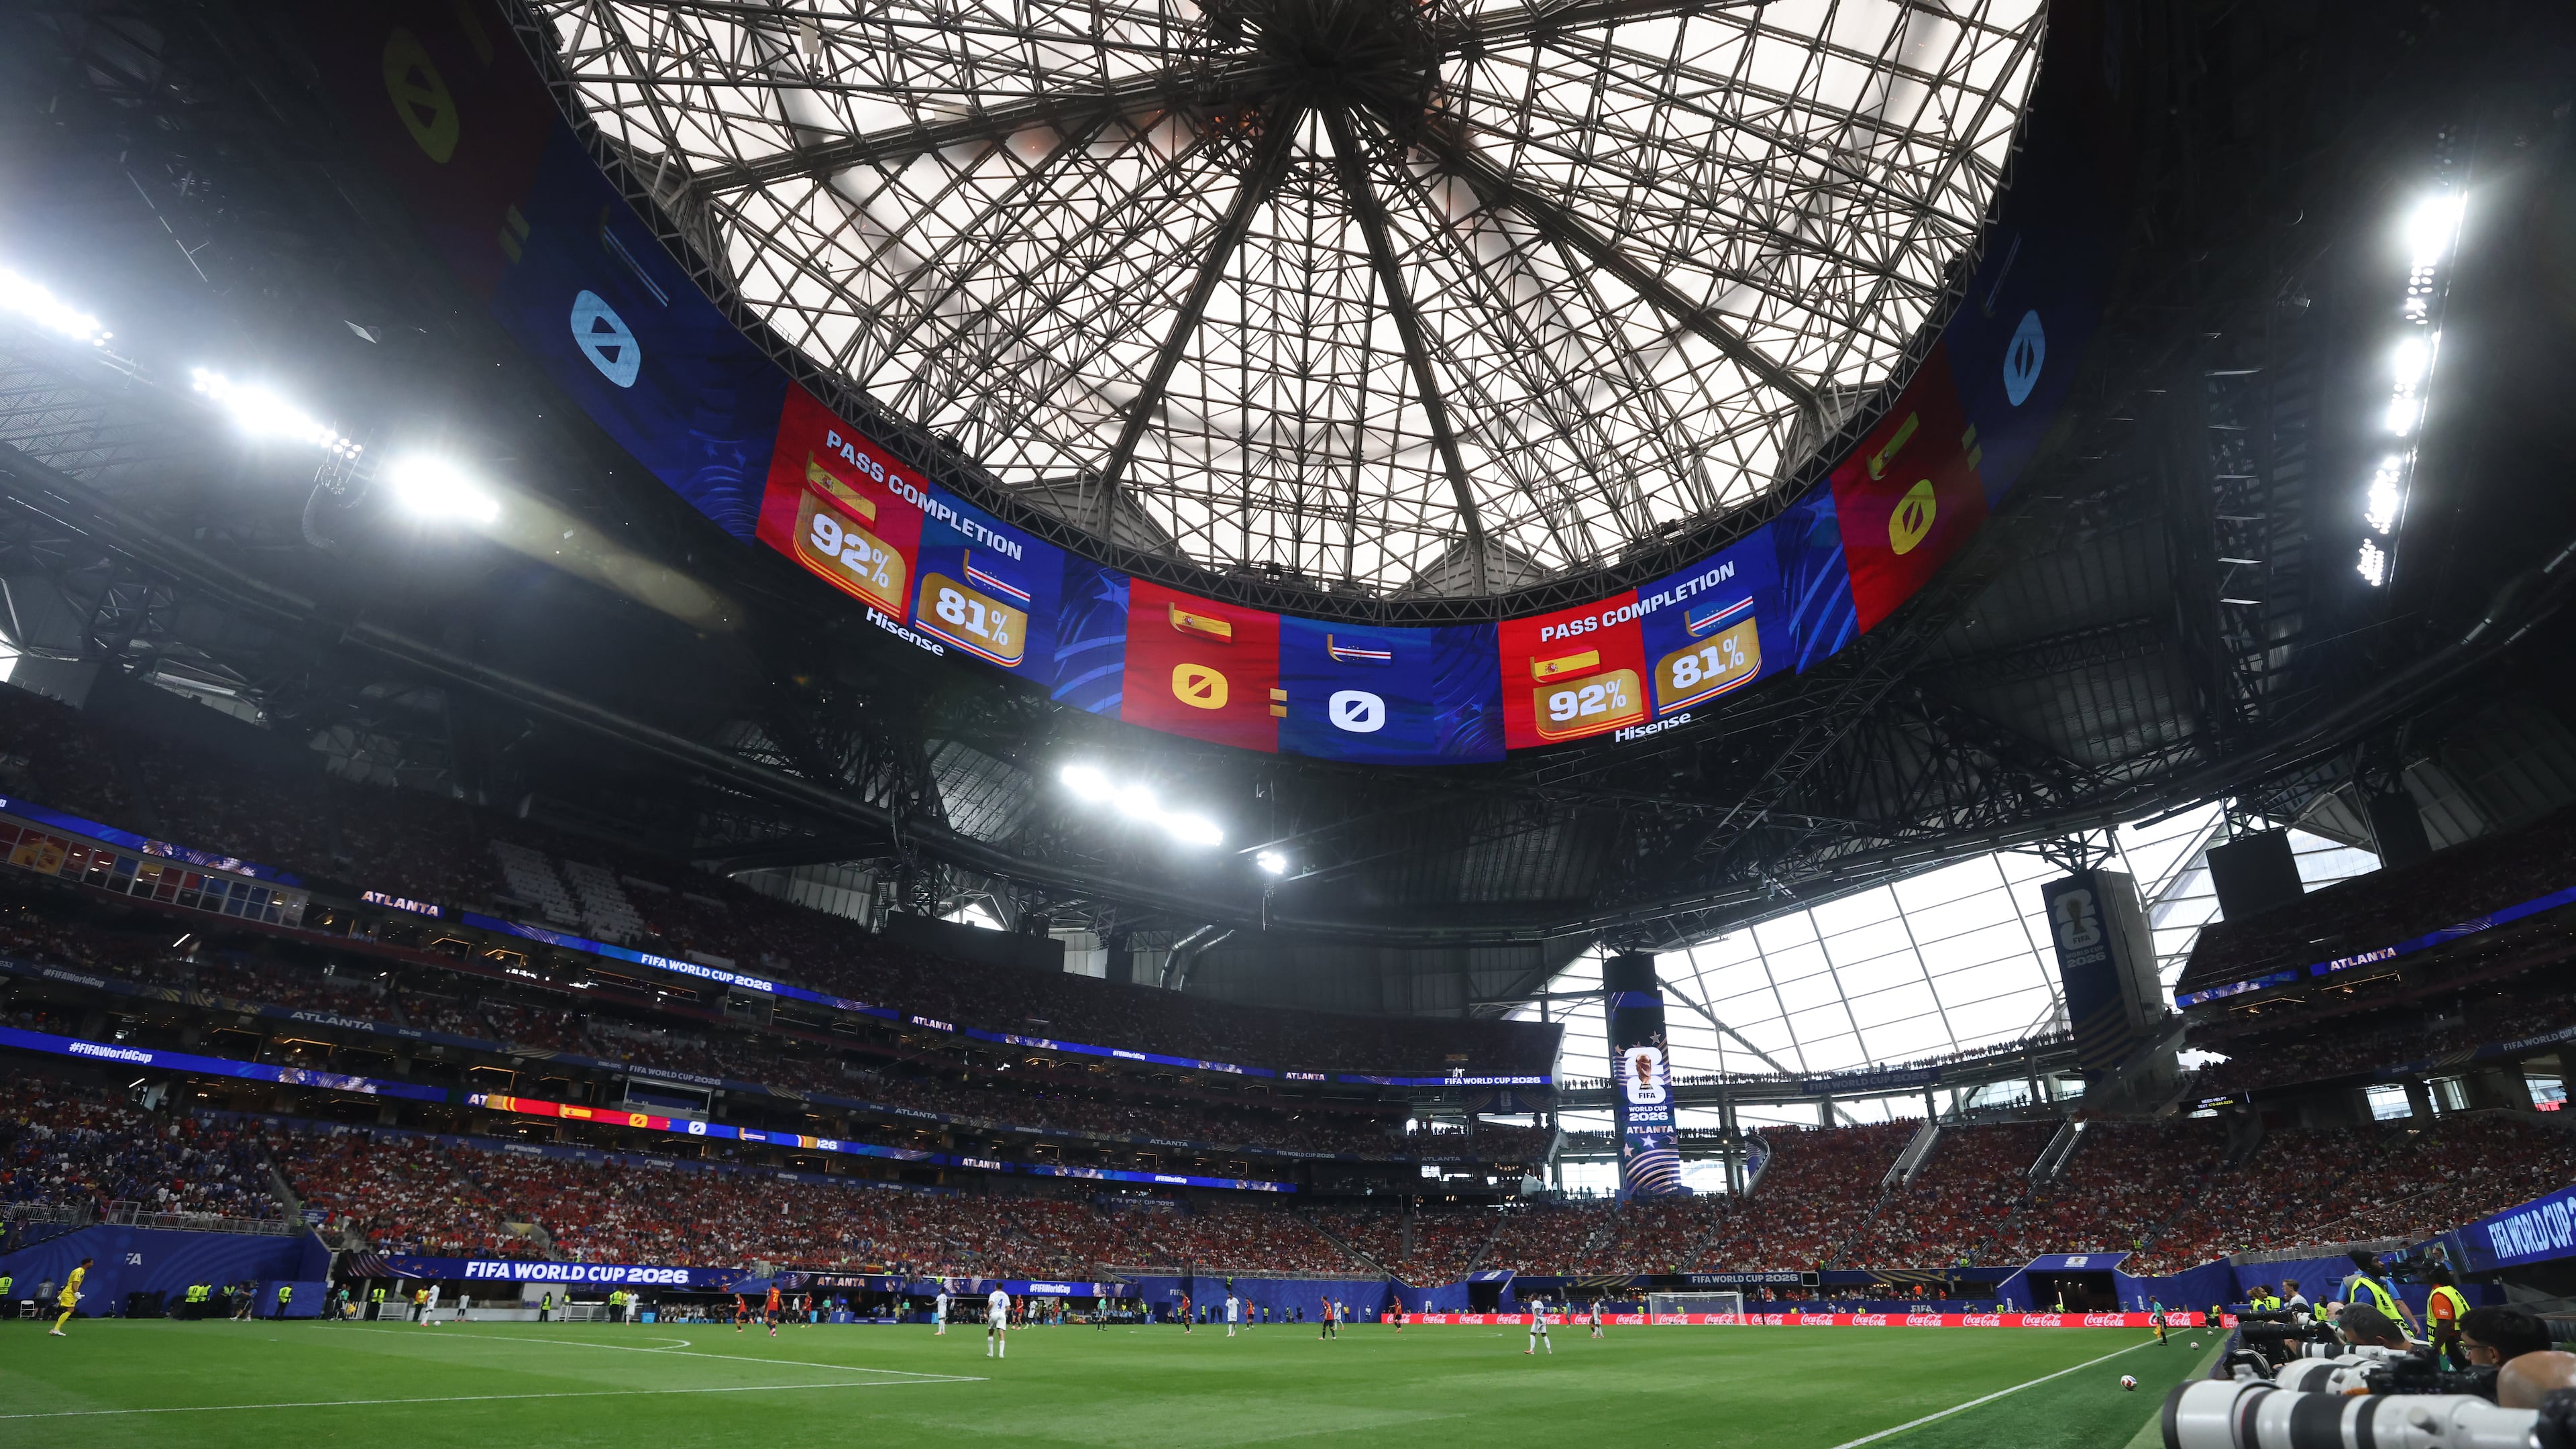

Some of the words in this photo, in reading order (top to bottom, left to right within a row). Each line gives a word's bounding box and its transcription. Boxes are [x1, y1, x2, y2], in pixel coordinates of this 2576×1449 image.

[826, 429, 885, 483] PASS
[888, 473, 1023, 561] COMPLETION
[810, 513, 890, 589] 92%
[1541, 614, 1599, 642] PASS
[1602, 561, 1735, 627] COMPLETION
[936, 586, 1008, 646] 81%
[866, 606, 945, 657] Hisense
[1672, 635, 1744, 689] 81%
[1172, 663, 1228, 709] 0
[1548, 679, 1627, 722] 92%
[1329, 690, 1386, 733] 0
[1615, 713, 1691, 743] Hisense
[362, 890, 439, 917] ATLANTA
[2065, 948, 2090, 959] WORLD
[2067, 952, 2106, 968] 2026
[2330, 947, 2397, 971] ATLANTA
[43, 969, 105, 987] #FIFAWorldCup
[641, 954, 667, 968] FIFA
[668, 959, 711, 977] WORLD
[711, 970, 735, 982] CUP
[734, 975, 773, 991] 2026
[290, 1011, 374, 1030] ATLANTA
[912, 1016, 953, 1032] ATLANTA
[2502, 1040, 2524, 1051] FIFA
[2523, 1033, 2559, 1047] WORLD
[2559, 1029, 2573, 1040] CUP
[69, 1042, 153, 1064] #FIFAWorldCup
[629, 1065, 647, 1074] FIFA
[648, 1067, 677, 1079] WORLD
[678, 1073, 694, 1081] CUP
[694, 1075, 721, 1085] 2026
[1286, 1072, 1326, 1081] ATLANTA
[1511, 1076, 1541, 1084] 2026
[629, 1113, 648, 1128] 0
[895, 1108, 937, 1120] ATLANTA
[1629, 1112, 1668, 1121] 2026
[688, 1121, 706, 1135] 0
[1627, 1126, 1674, 1134] ATLANTA
[962, 1158, 1001, 1170] ATLANTA
[2487, 1221, 2516, 1259] FIFA
[2504, 1210, 2550, 1254] WORLD
[2542, 1201, 2574, 1248] CUP
[465, 1261, 510, 1278] FIFA
[515, 1263, 586, 1281] WORLD
[588, 1266, 625, 1282] CUP
[626, 1268, 688, 1284] 2026
[1692, 1275, 1711, 1283] FIFA
[1711, 1275, 1744, 1283] WORLD
[1765, 1274, 1799, 1282] 2026
[817, 1277, 865, 1287] ATLANTA
[1029, 1283, 1071, 1295] #FIFAWorldCup
[773, 1293, 779, 1302] 21
[998, 1298, 1003, 1309] 4
[1801, 1313, 1835, 1326] Coca-Cola
[1852, 1313, 1887, 1326] Coca-Cola
[1906, 1313, 1943, 1326] Coca-Cola
[1963, 1313, 2001, 1327] Coca-Cola
[2022, 1313, 2063, 1327] Coca-Cola
[2084, 1313, 2125, 1327] Coca-Cola
